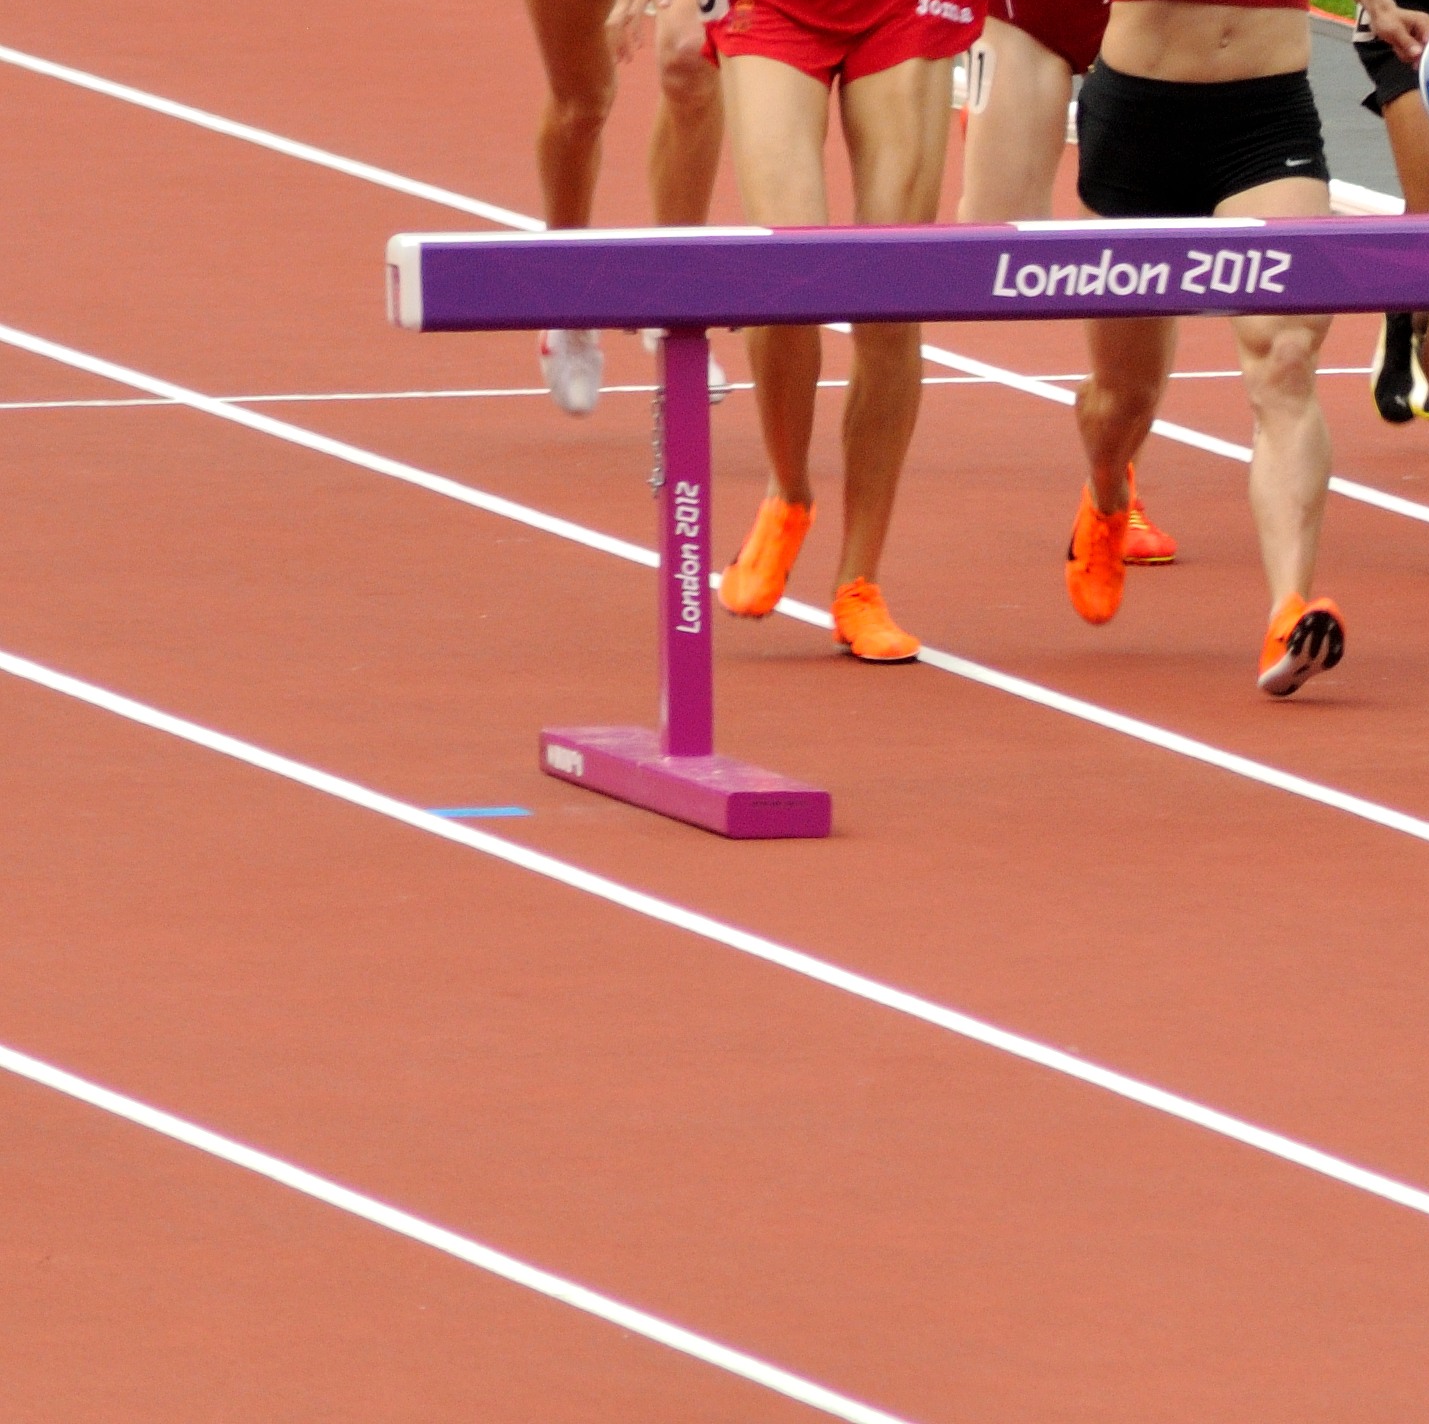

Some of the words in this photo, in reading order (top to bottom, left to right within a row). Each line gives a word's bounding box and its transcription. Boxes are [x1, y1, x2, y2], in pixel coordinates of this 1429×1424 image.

[992, 249, 1172, 298] London
[1180, 249, 1292, 295] 2012
[674, 481, 700, 538] 2012
[674, 544, 701, 634] London
